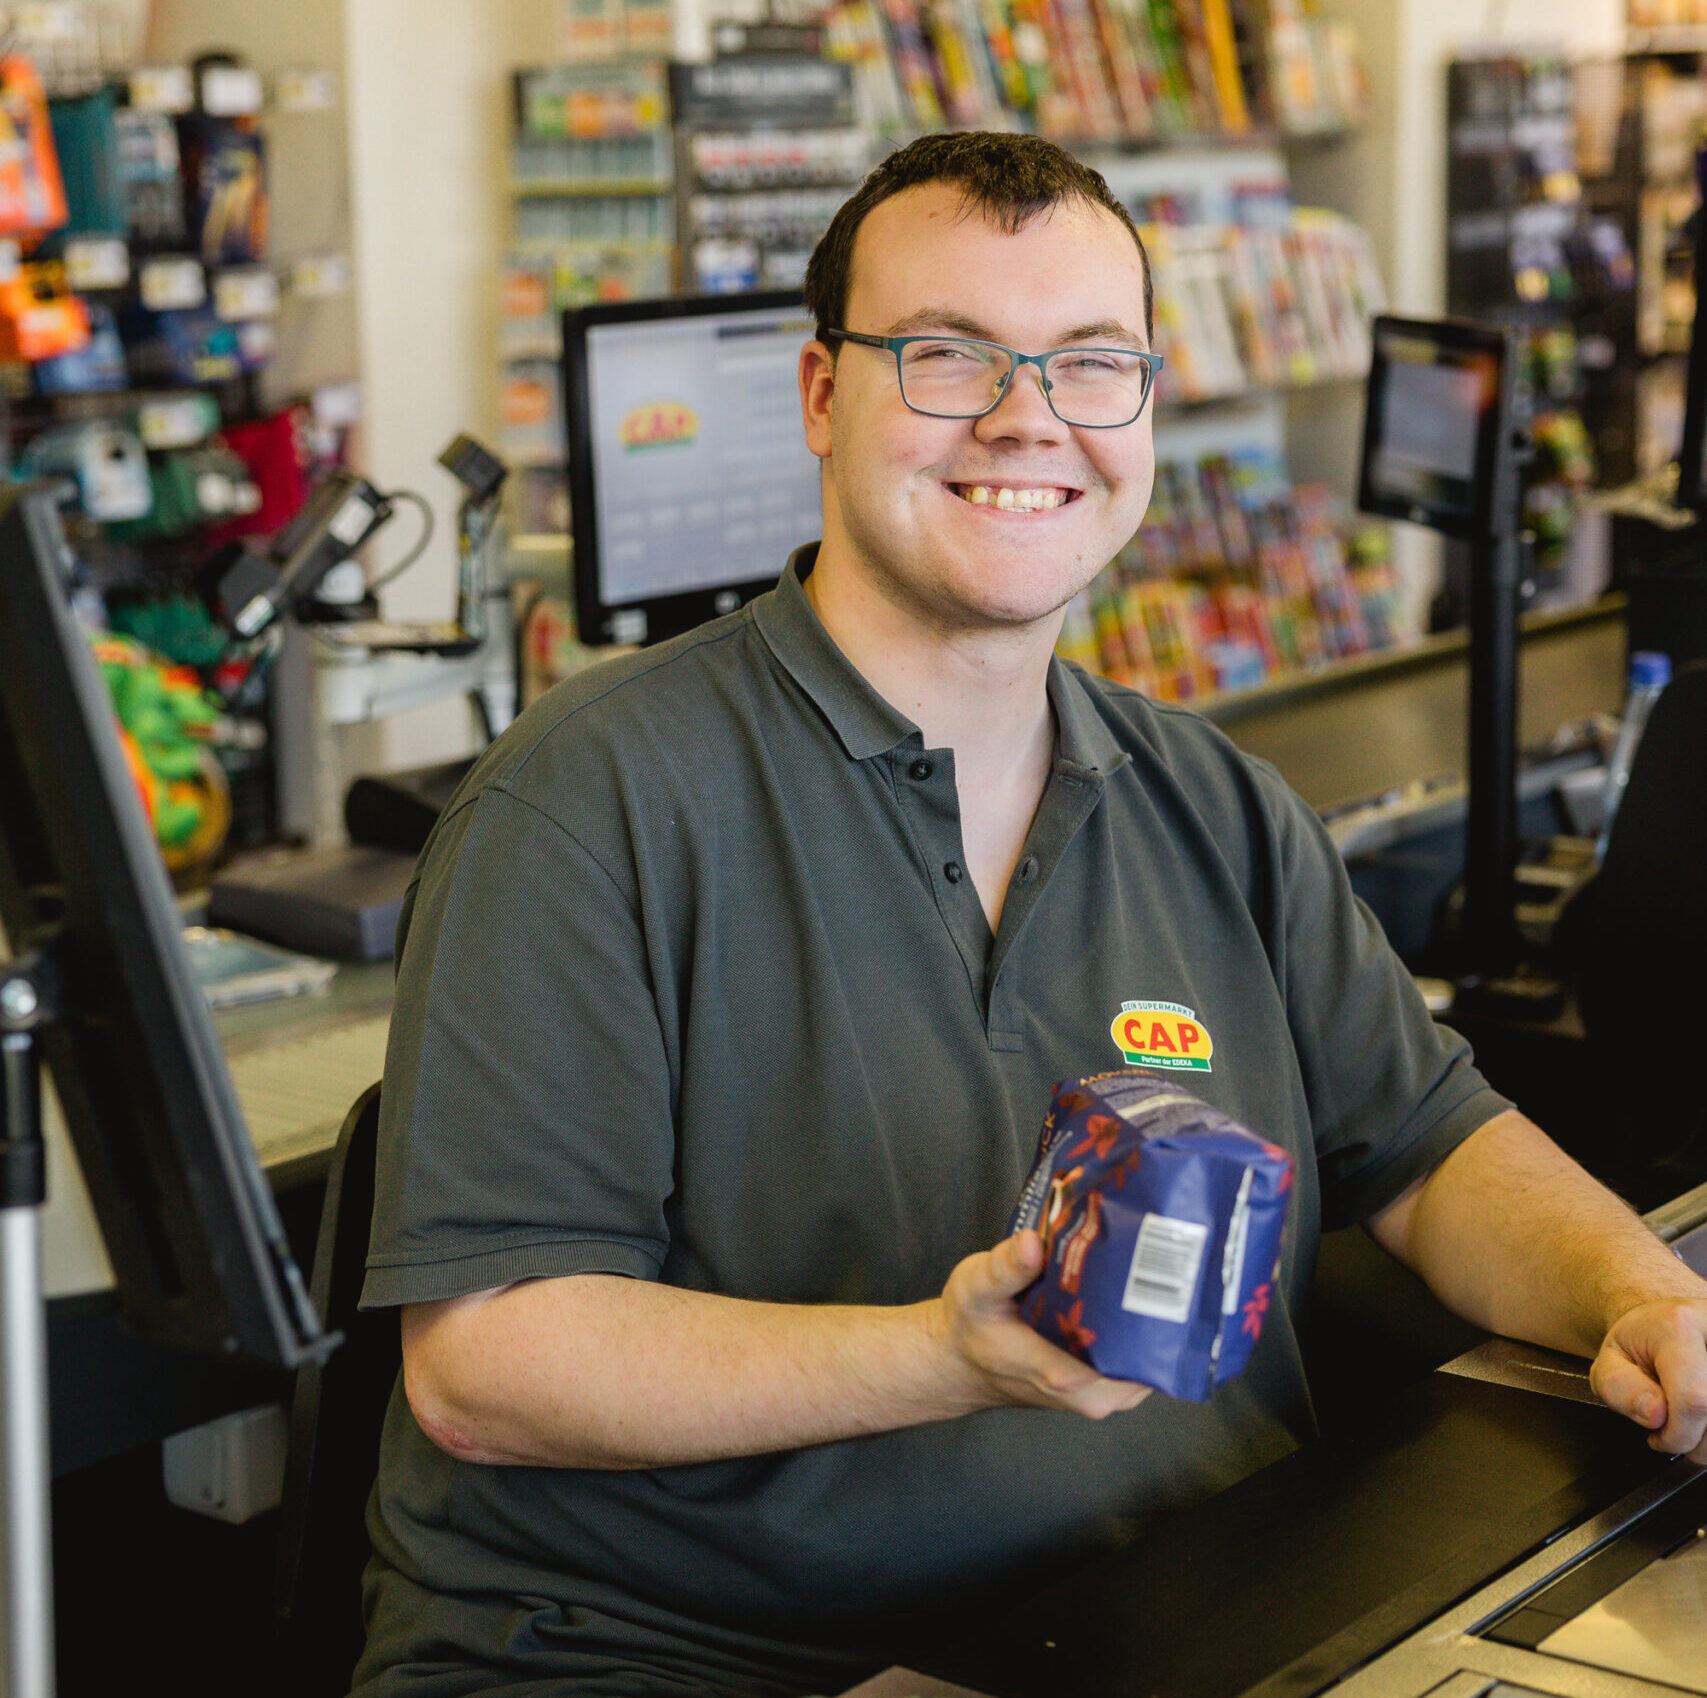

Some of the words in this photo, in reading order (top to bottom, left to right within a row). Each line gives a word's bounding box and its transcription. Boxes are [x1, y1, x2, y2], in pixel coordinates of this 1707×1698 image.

[1123, 1002, 1136, 1011] DEIN
[1138, 1002, 1192, 1017] SUPERMARKT
[1124, 1019, 1199, 1053] CAP
[1141, 1056, 1161, 1064] Partner
[1163, 1057, 1171, 1065] der
[1172, 1058, 1192, 1066] EDEKA
